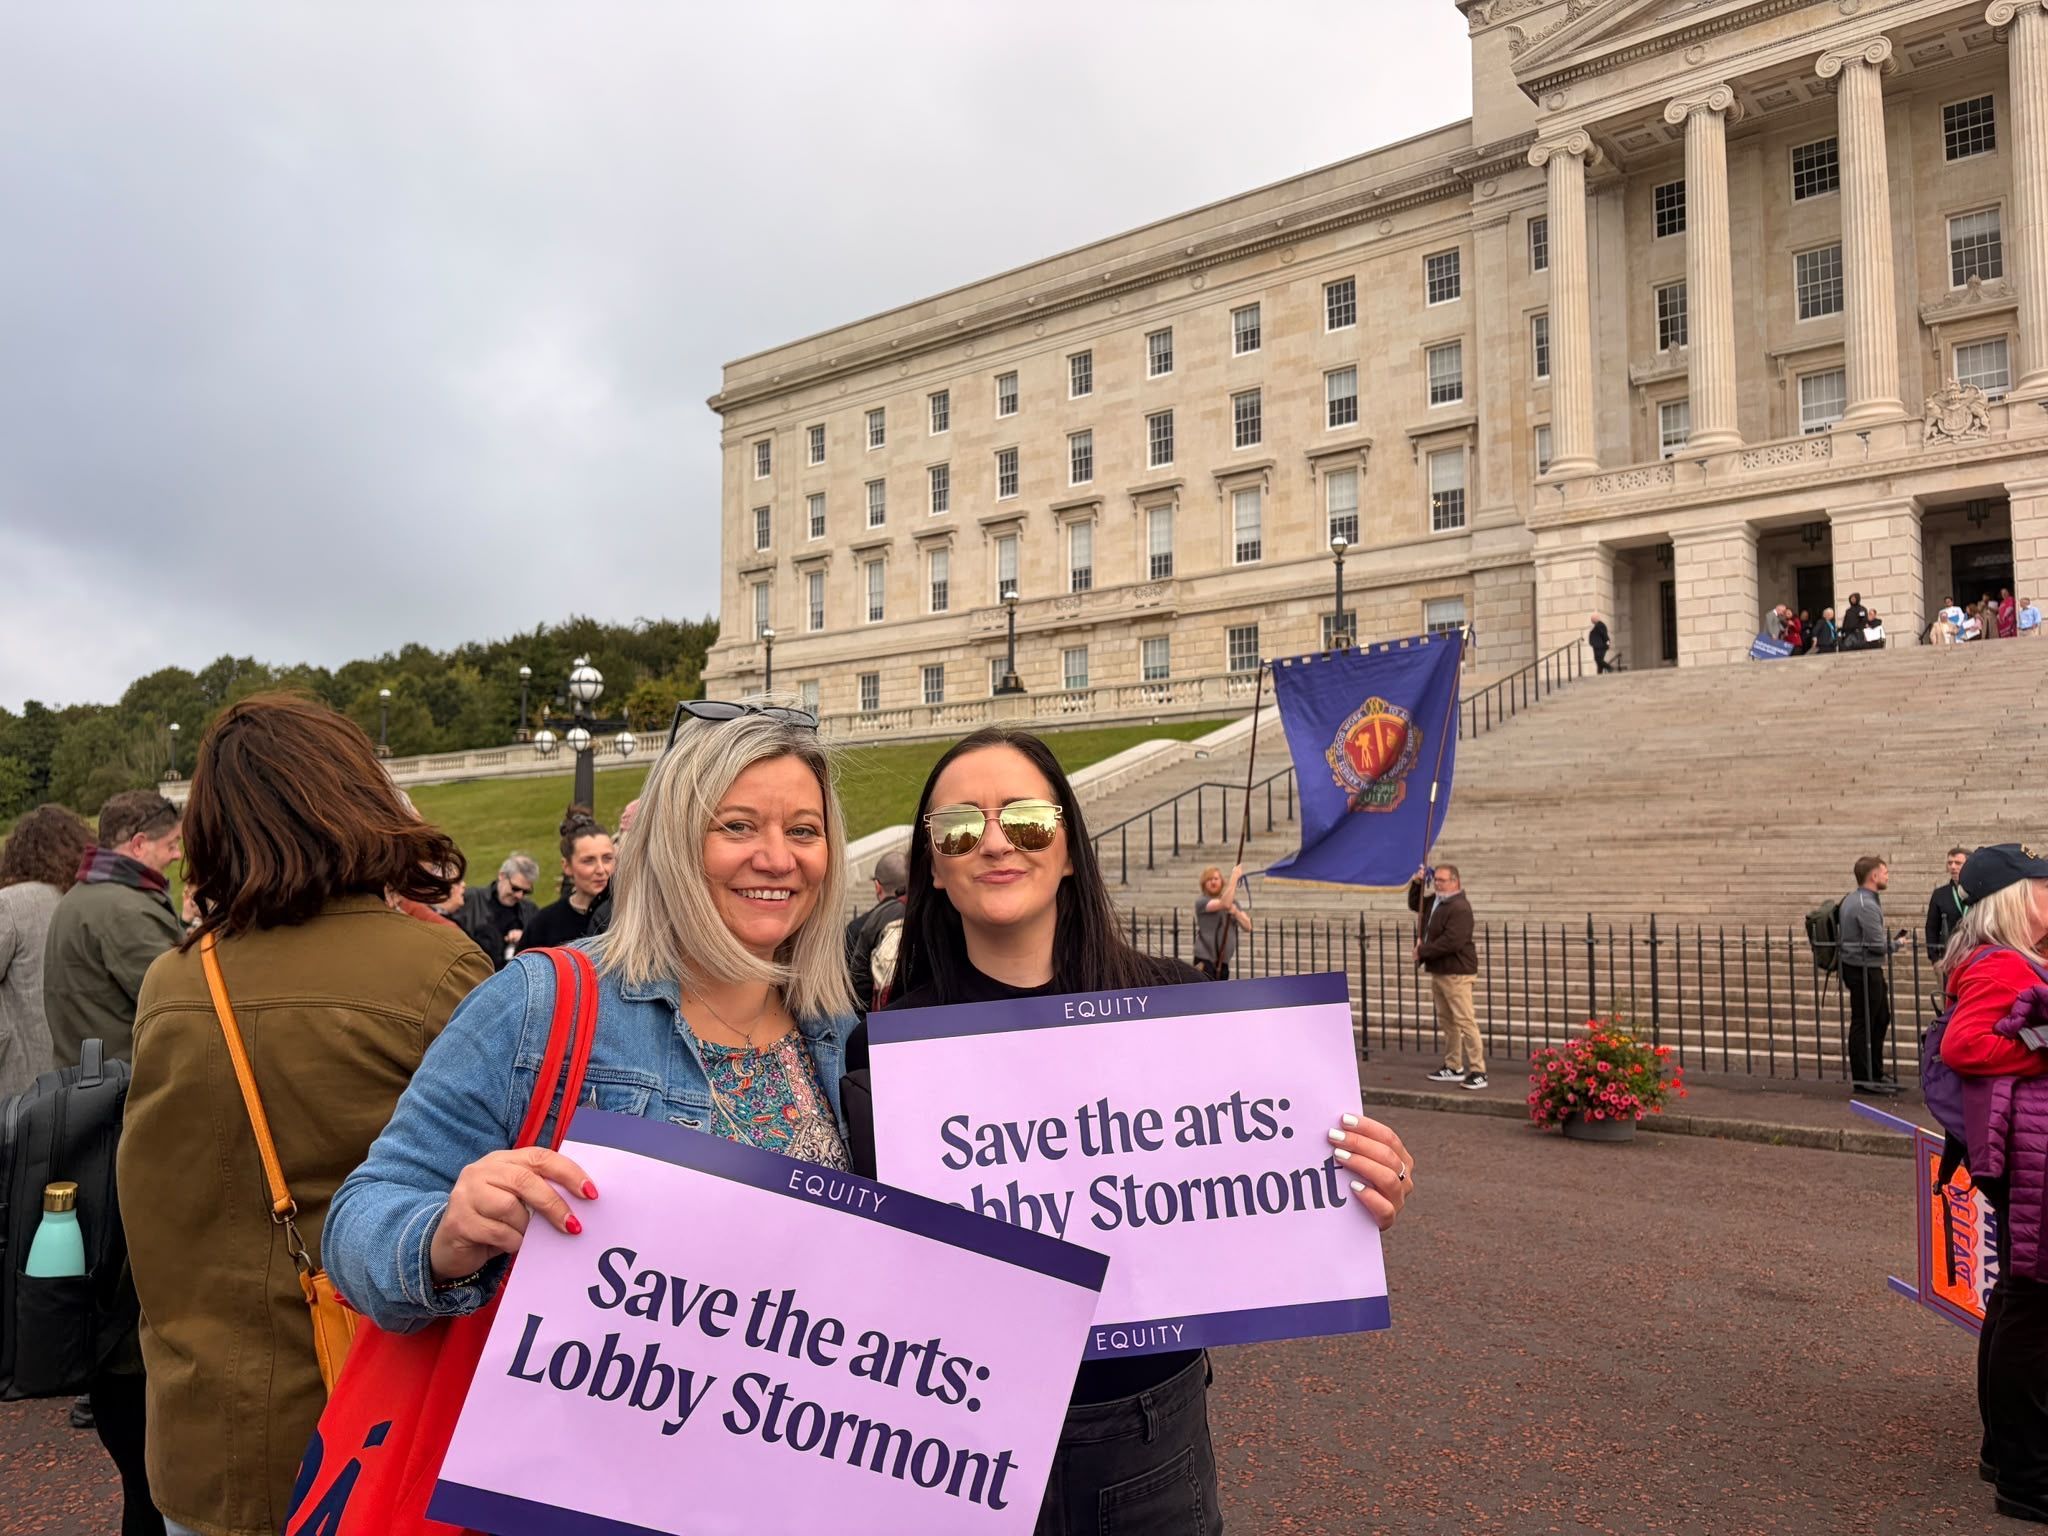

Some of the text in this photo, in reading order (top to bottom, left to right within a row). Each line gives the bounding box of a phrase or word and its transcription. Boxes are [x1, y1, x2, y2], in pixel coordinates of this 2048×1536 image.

[1335, 712, 1362, 756] GOOD WORK
[1064, 995, 1149, 1020] EQUITY
[940, 1090, 1294, 1171] Save the arts:
[788, 1168, 888, 1214] EQUITY
[949, 1156, 1347, 1241] bby Stormont
[587, 1247, 991, 1413] Save the arts:
[1096, 1323, 1185, 1351] EQUITY
[506, 1313, 1019, 1511] Lobby Stormont
